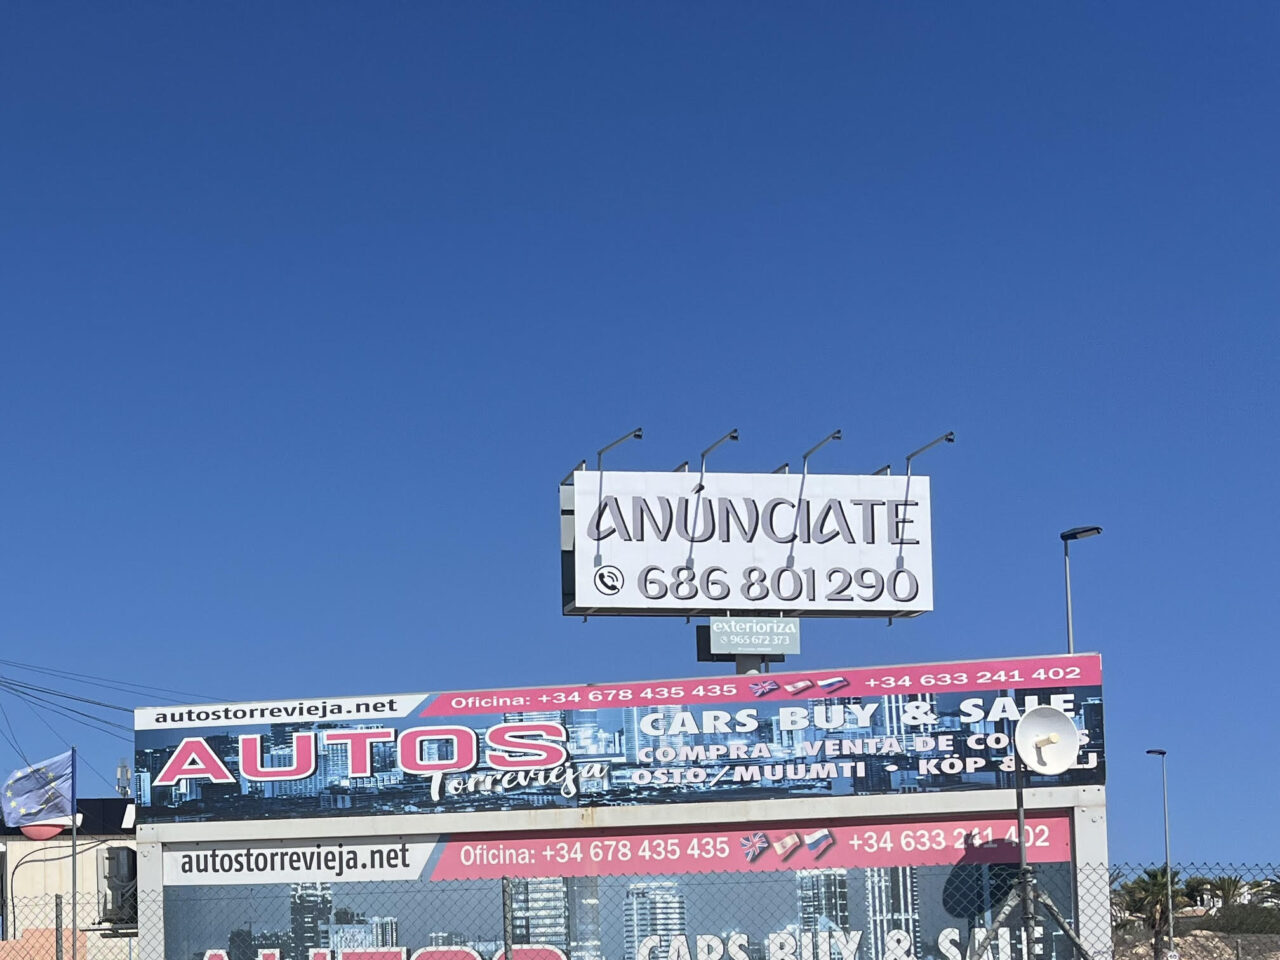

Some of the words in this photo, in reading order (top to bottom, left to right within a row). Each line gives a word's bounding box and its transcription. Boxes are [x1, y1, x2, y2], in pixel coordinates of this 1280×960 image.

[637, 564, 730, 601] 686
[740, 565, 816, 602] 801
[824, 566, 920, 602] 290
[712, 619, 797, 633] exterioriza
[730, 634, 751, 645] 965
[751, 634, 770, 645] 672
[772, 634, 790, 645] 373
[155, 698, 398, 724] autostorrevieja.net
[451, 692, 531, 709] Oficina:
[538, 690, 580, 704] +34
[587, 689, 634, 703] 678
[640, 686, 685, 700] 435
[691, 684, 737, 698] 435
[864, 674, 913, 690] +34
[919, 671, 970, 687] 633
[975, 669, 1024, 684] 241
[1031, 666, 1081, 681] 402
[639, 708, 759, 737] CARS
[780, 702, 879, 731] BUY
[901, 700, 939, 725] &
[152, 723, 569, 787] AUTOS
[638, 743, 773, 764] COMPRA
[803, 736, 904, 757] VENTA
[914, 734, 953, 753] DE
[919, 752, 986, 777] KÖP
[422, 760, 610, 801] Torrevieja
[181, 843, 410, 876] autostorrevieja.net
[460, 842, 536, 866] Oficina:
[542, 841, 583, 863] +34
[589, 839, 631, 862] 678
[638, 838, 681, 860] 435
[687, 836, 730, 859] 435
[848, 830, 894, 854] +34
[900, 828, 947, 851] 633
[953, 826, 998, 849] 241
[1004, 824, 1050, 848] 402
